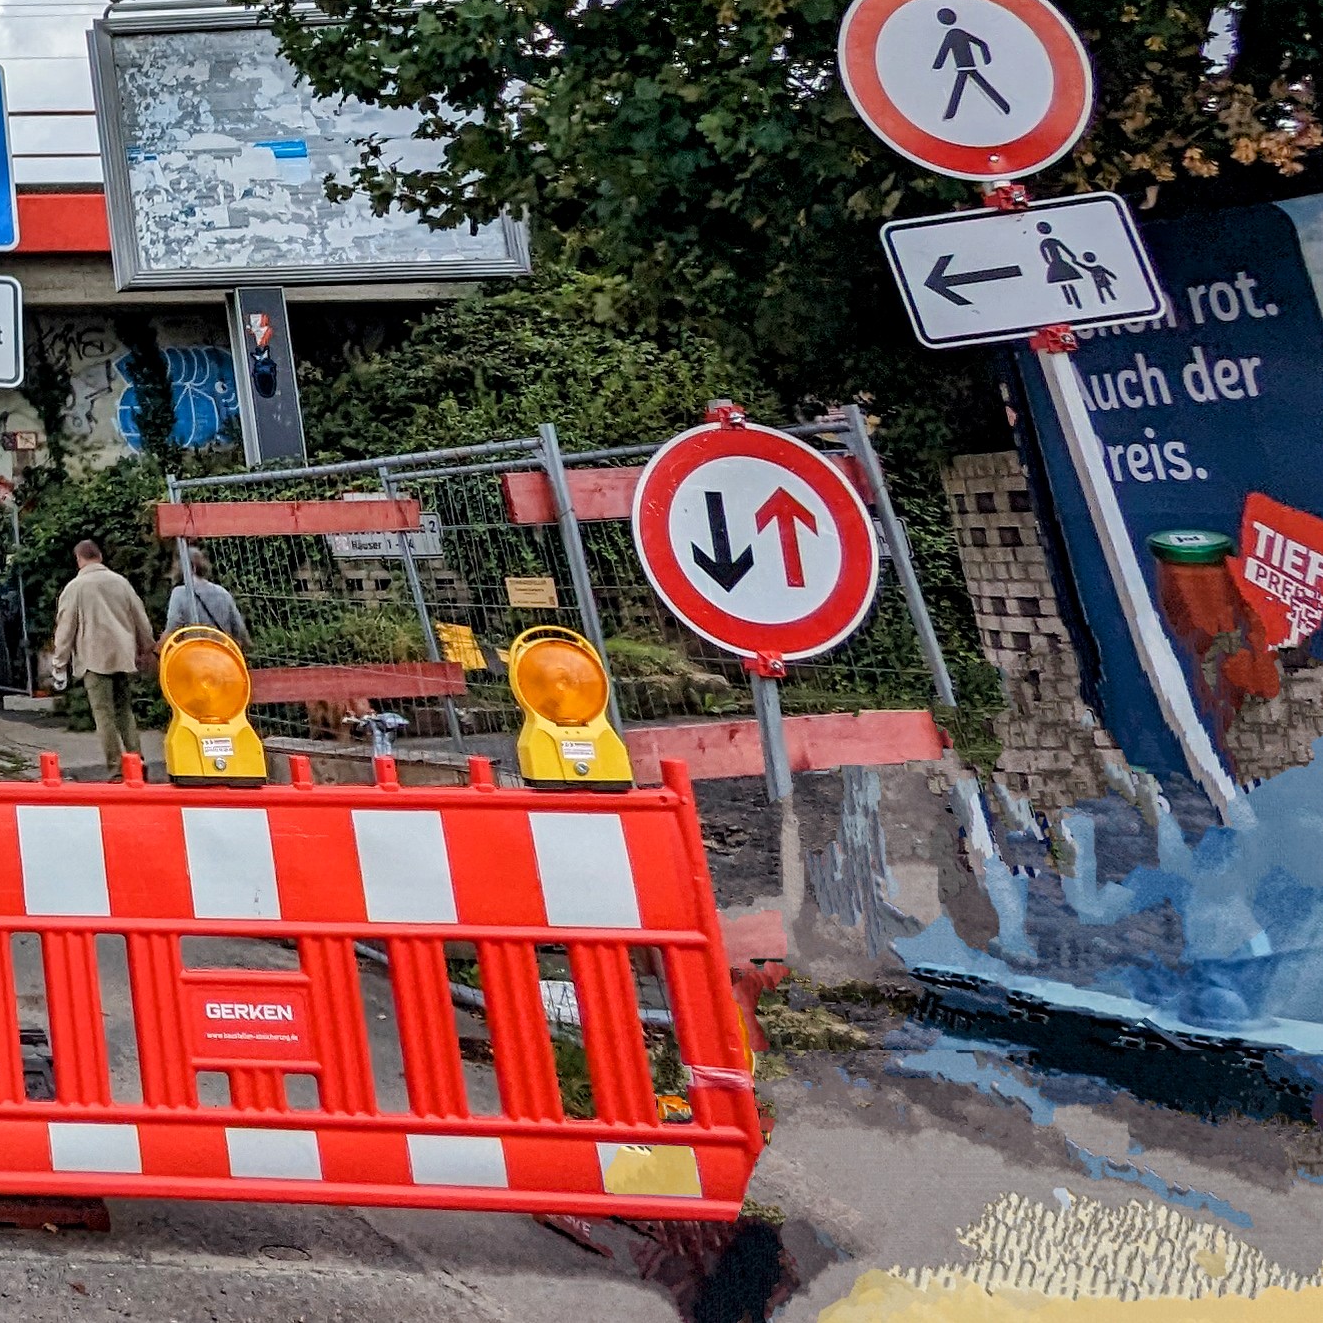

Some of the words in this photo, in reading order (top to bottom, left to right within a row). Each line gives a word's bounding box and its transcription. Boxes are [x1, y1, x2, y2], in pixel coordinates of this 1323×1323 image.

[1187, 271, 1280, 324] rot.
[1182, 345, 1261, 403] der
[1095, 427, 1209, 482] reis.
[205, 1003, 294, 1021] GERKEN
